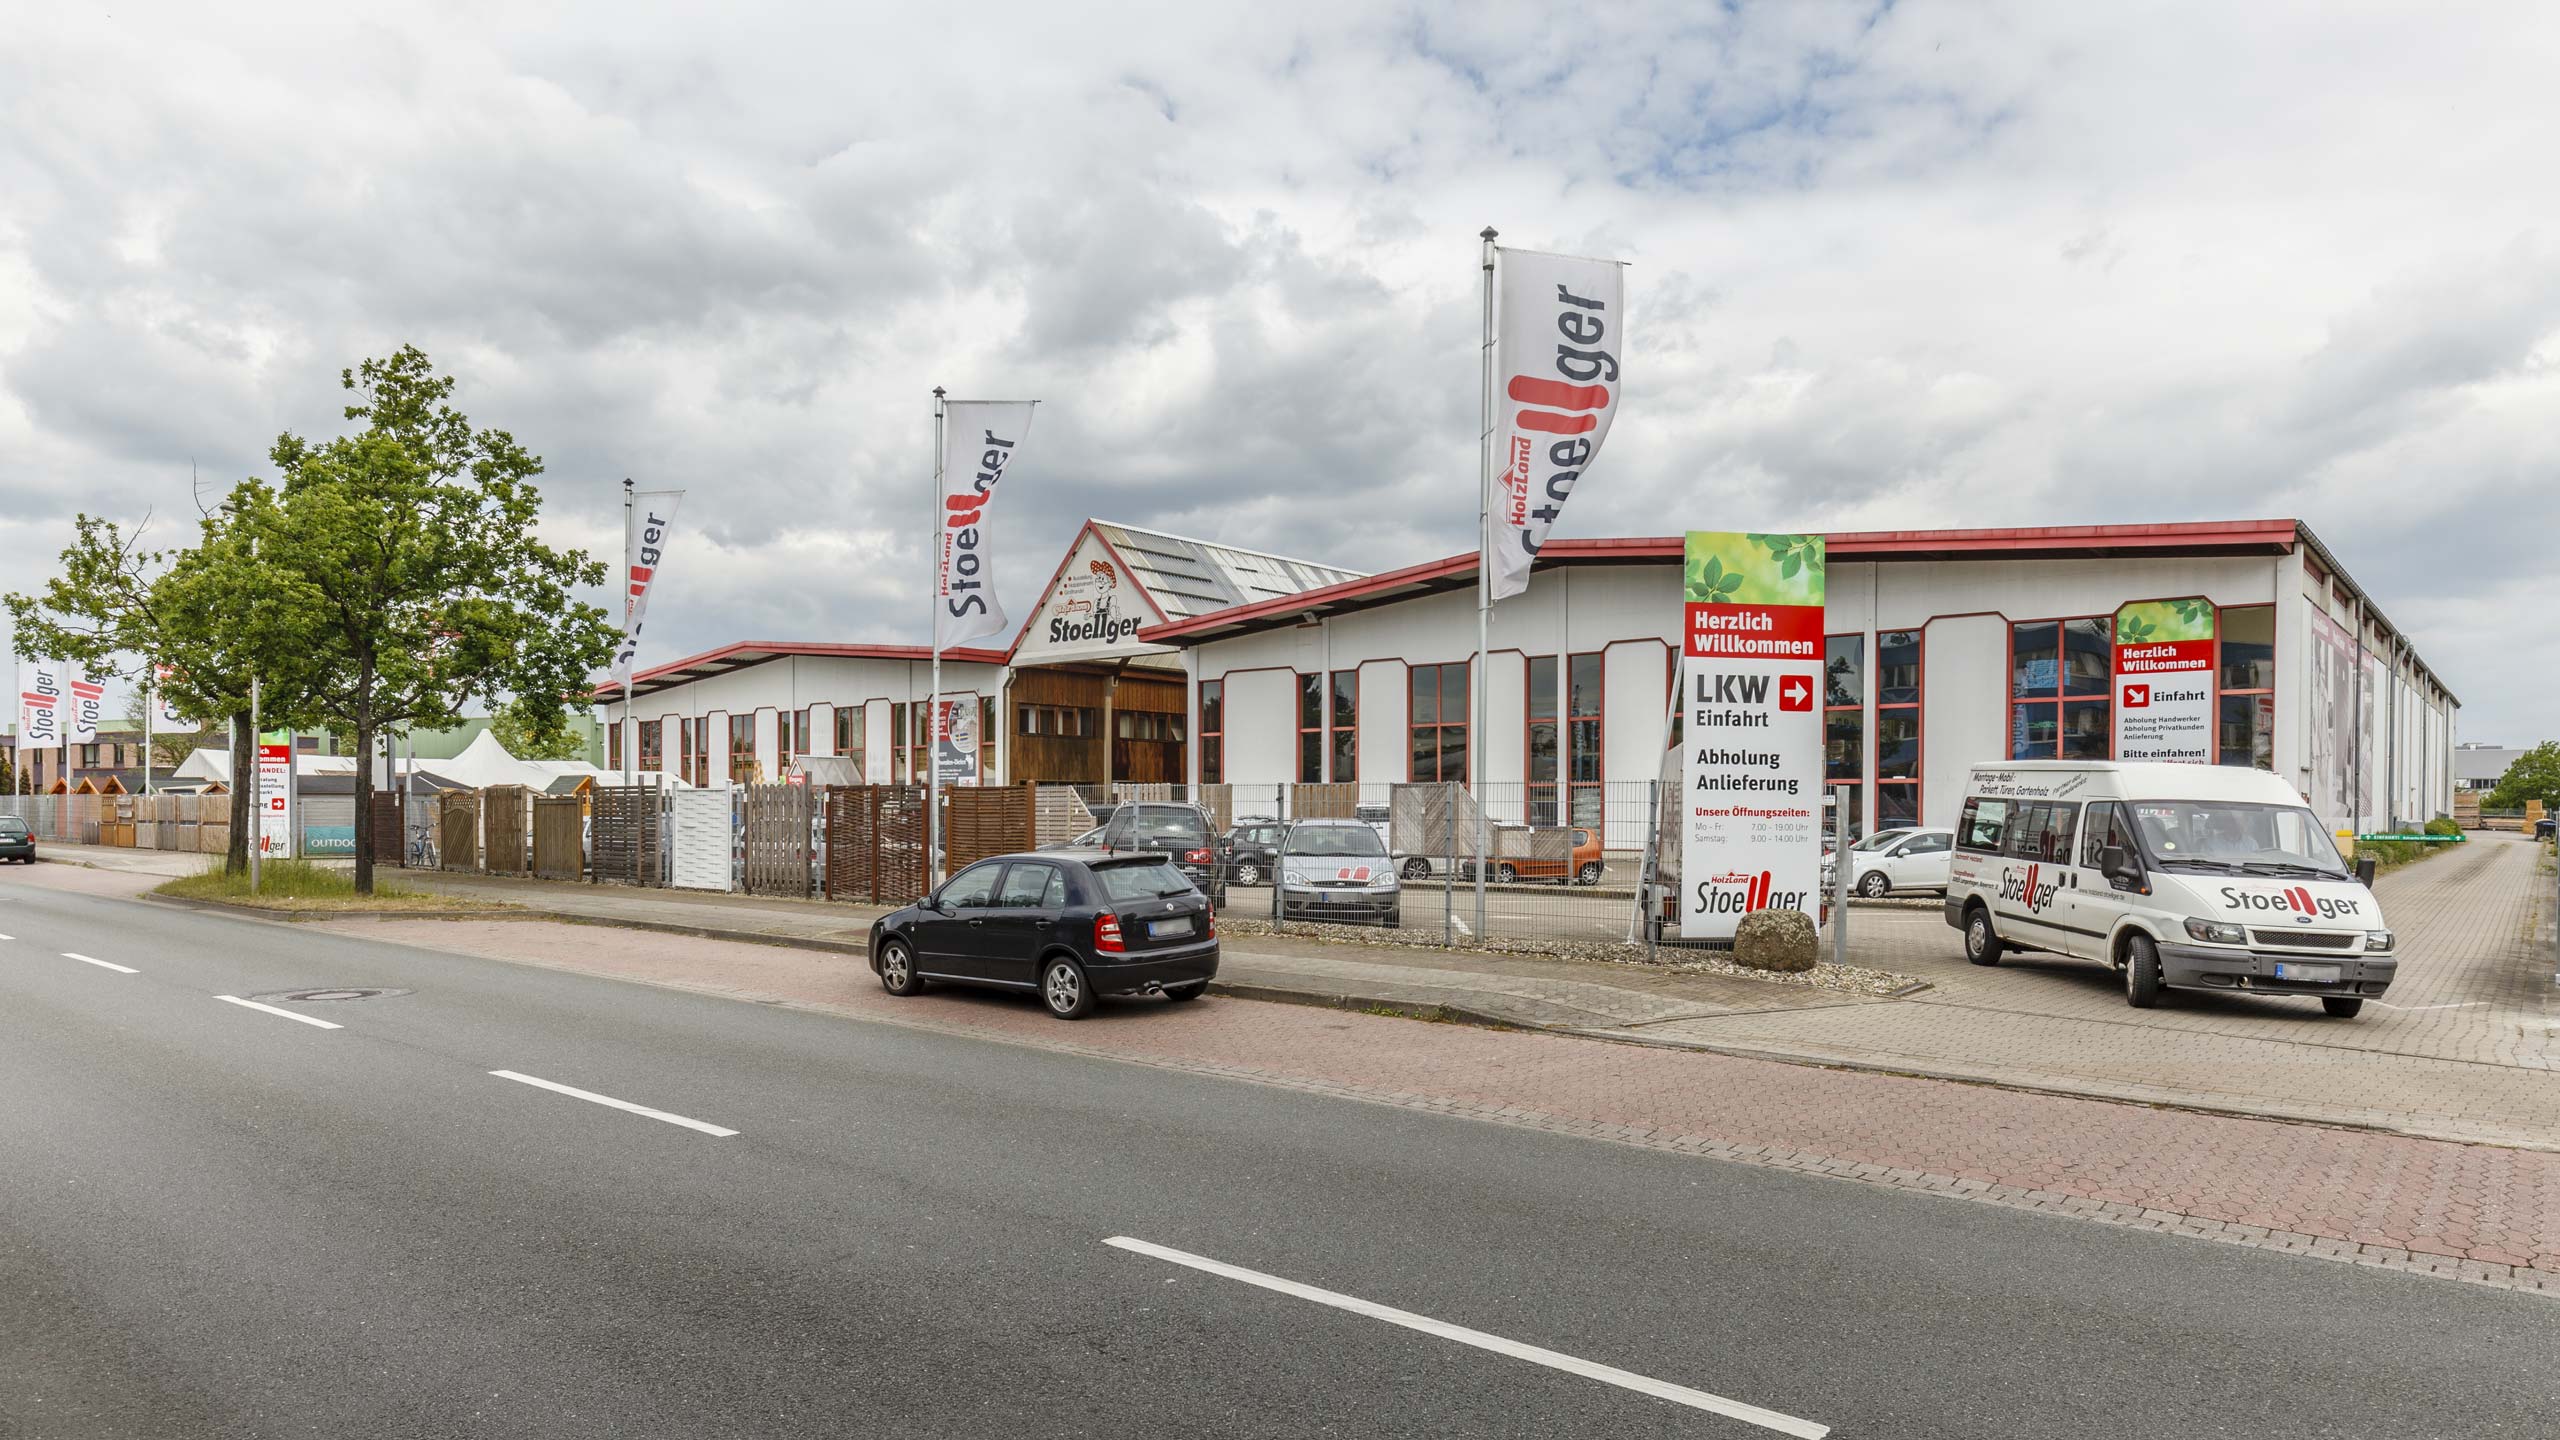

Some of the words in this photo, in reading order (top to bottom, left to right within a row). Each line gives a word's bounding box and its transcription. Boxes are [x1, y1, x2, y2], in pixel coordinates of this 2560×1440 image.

[1511, 437, 1531, 526] HolzLand
[941, 533, 952, 596] HolzLand
[1049, 616, 1141, 644] Stoellger
[1695, 611, 1773, 631] Herzlich
[1694, 633, 1814, 655] Willkommen
[2123, 645, 2176, 659] Herzlich
[2123, 659, 2206, 672] Willkommen
[1696, 674, 1770, 704] LKW
[2154, 690, 2206, 702] Einfahrt
[22, 669, 60, 741] Stoellger
[1696, 709, 1769, 727] Einfahrt
[1697, 749, 1780, 769] Abholung
[2123, 749, 2149, 758] Bitte
[2151, 748, 2206, 757] einfahren!
[1696, 774, 1799, 795] Anlieferung
[1973, 772, 2016, 784] Montage-Mobil:
[2016, 785, 2049, 797] Gartenholz
[1695, 807, 1730, 817] Unsere
[1732, 805, 1810, 819] Öffnungszeiten:
[1695, 823, 1707, 831] Mo
[1751, 823, 1767, 832] 7.00
[1775, 823, 1794, 832] 19.00
[1795, 824, 1809, 832] Uhr
[1750, 834, 1767, 843] 9.00
[1775, 834, 1794, 843] 14.00
[1795, 835, 1809, 843] Uhr
[1711, 875, 1750, 884] HolzLand
[1999, 863, 2058, 914] Stoellger
[2220, 886, 2360, 919] Stoellger
